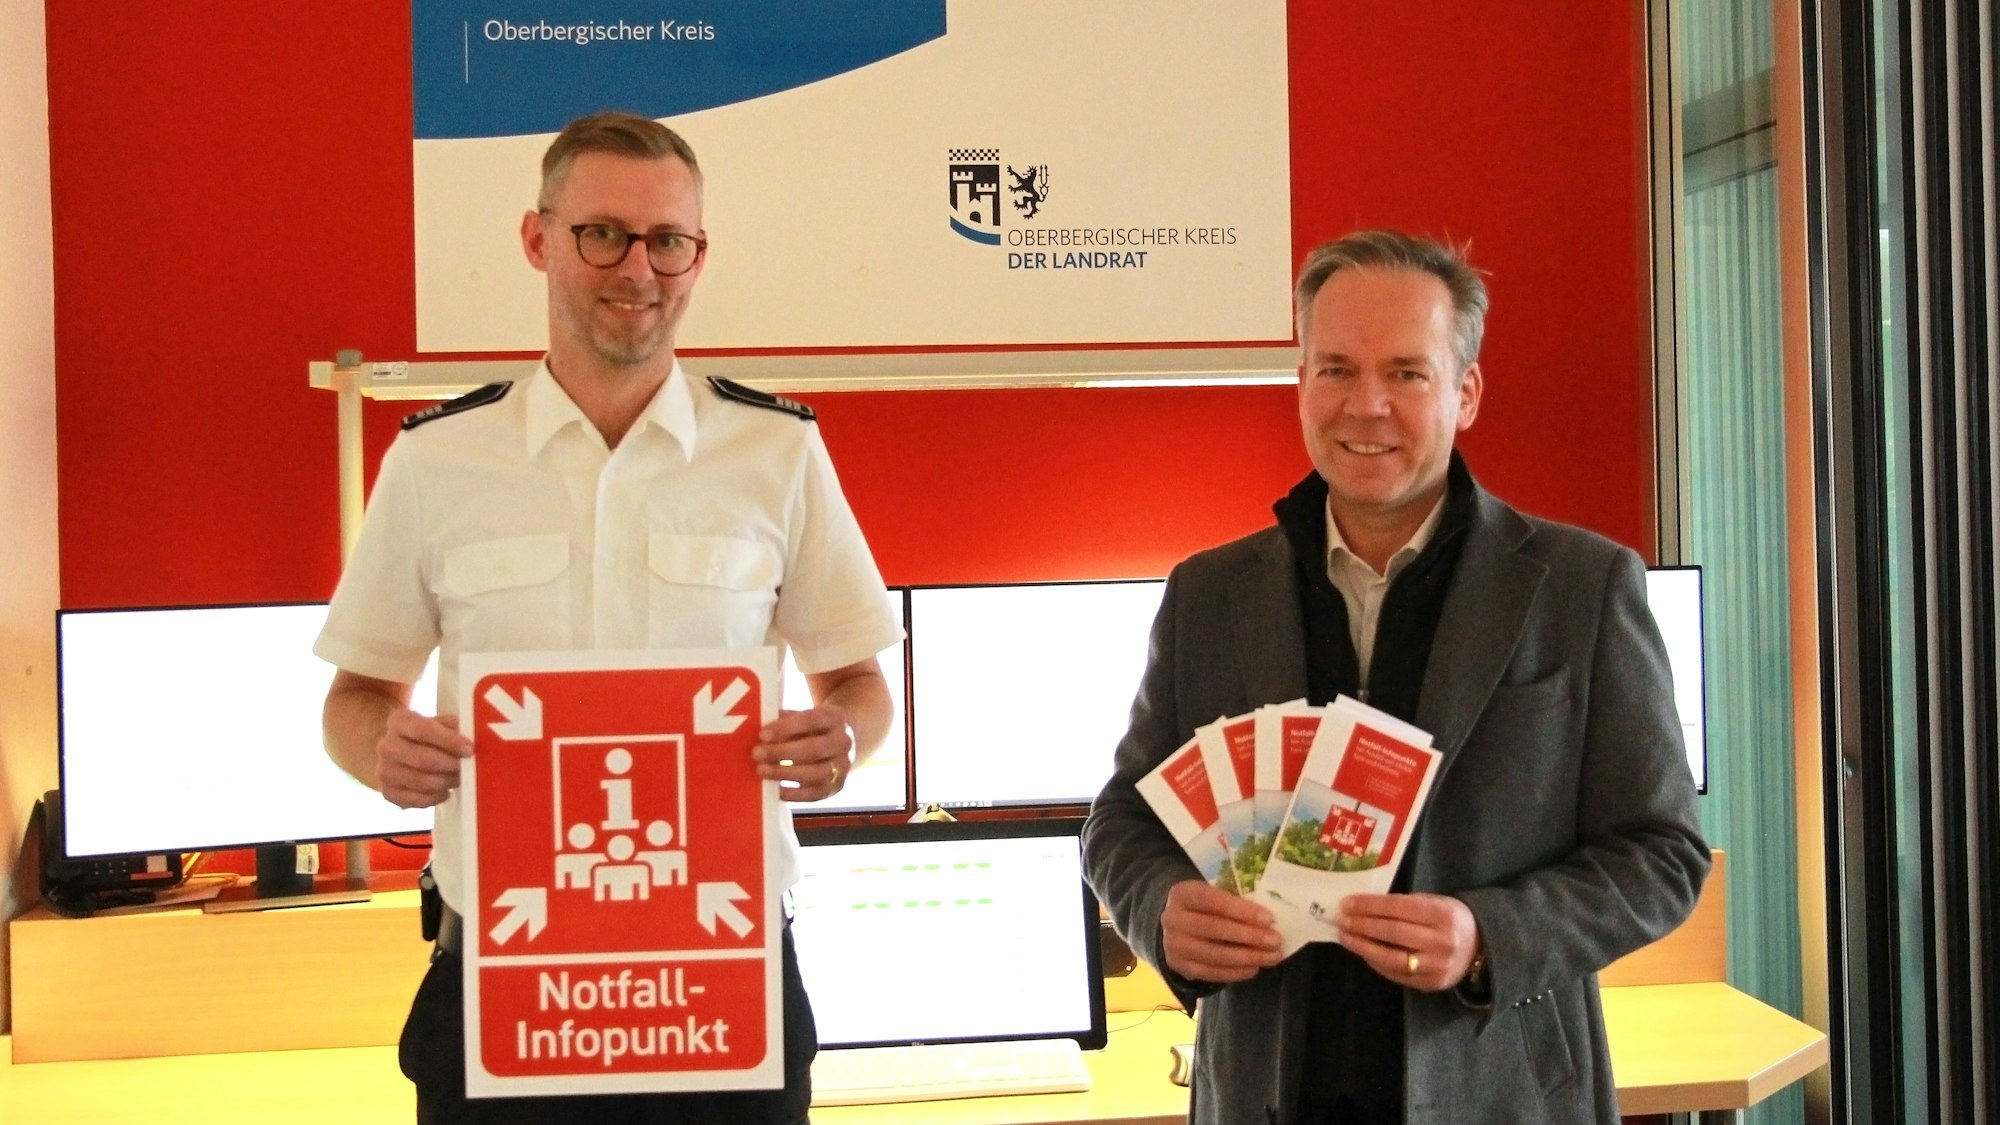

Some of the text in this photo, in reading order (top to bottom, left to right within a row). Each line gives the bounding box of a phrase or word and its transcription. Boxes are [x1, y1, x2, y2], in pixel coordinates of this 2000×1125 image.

[484, 20, 715, 45] Oberbergischer Kreis
[1008, 227, 1237, 246] OBERBERGISCHER KREIS
[1008, 252, 1147, 269] DER LANDRAT
[538, 968, 706, 1011] Notfall-
[517, 1016, 730, 1066] Infopunkt
